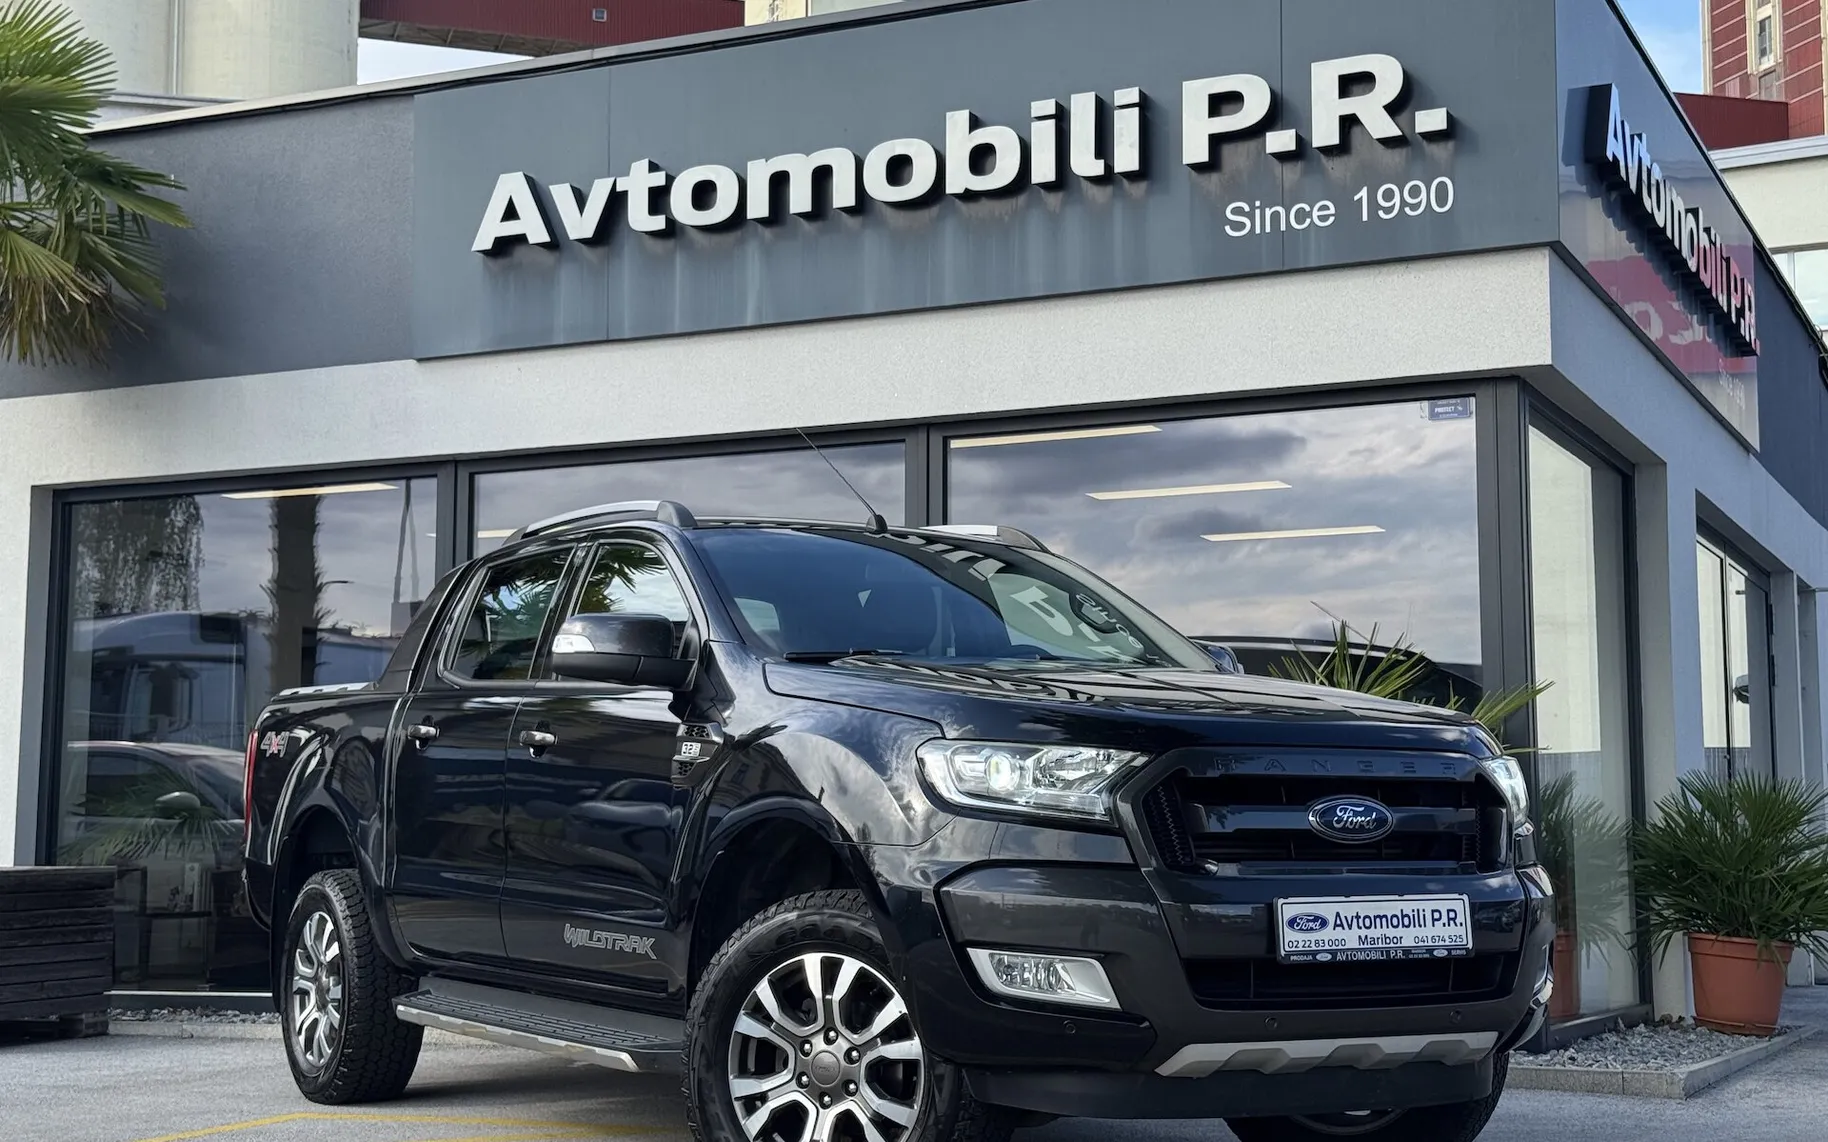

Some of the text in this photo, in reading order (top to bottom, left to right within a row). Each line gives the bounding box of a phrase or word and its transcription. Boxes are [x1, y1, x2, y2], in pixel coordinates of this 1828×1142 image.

[471, 52, 1450, 253] Avtomobili P.R.
[1223, 175, 1456, 238] Since 1990
[1605, 82, 1728, 313] Avtomobili
[1332, 805, 1377, 830] Ford
[1293, 908, 1464, 931] Ford Avtomobili P.R.
[563, 923, 657, 960] WILDTRAK
[1287, 933, 1464, 949] 02 22 83 000 Maribor 041 674 525
[1336, 949, 1387, 961] AVTOMOBILI
[1390, 949, 1406, 960] P.R.
